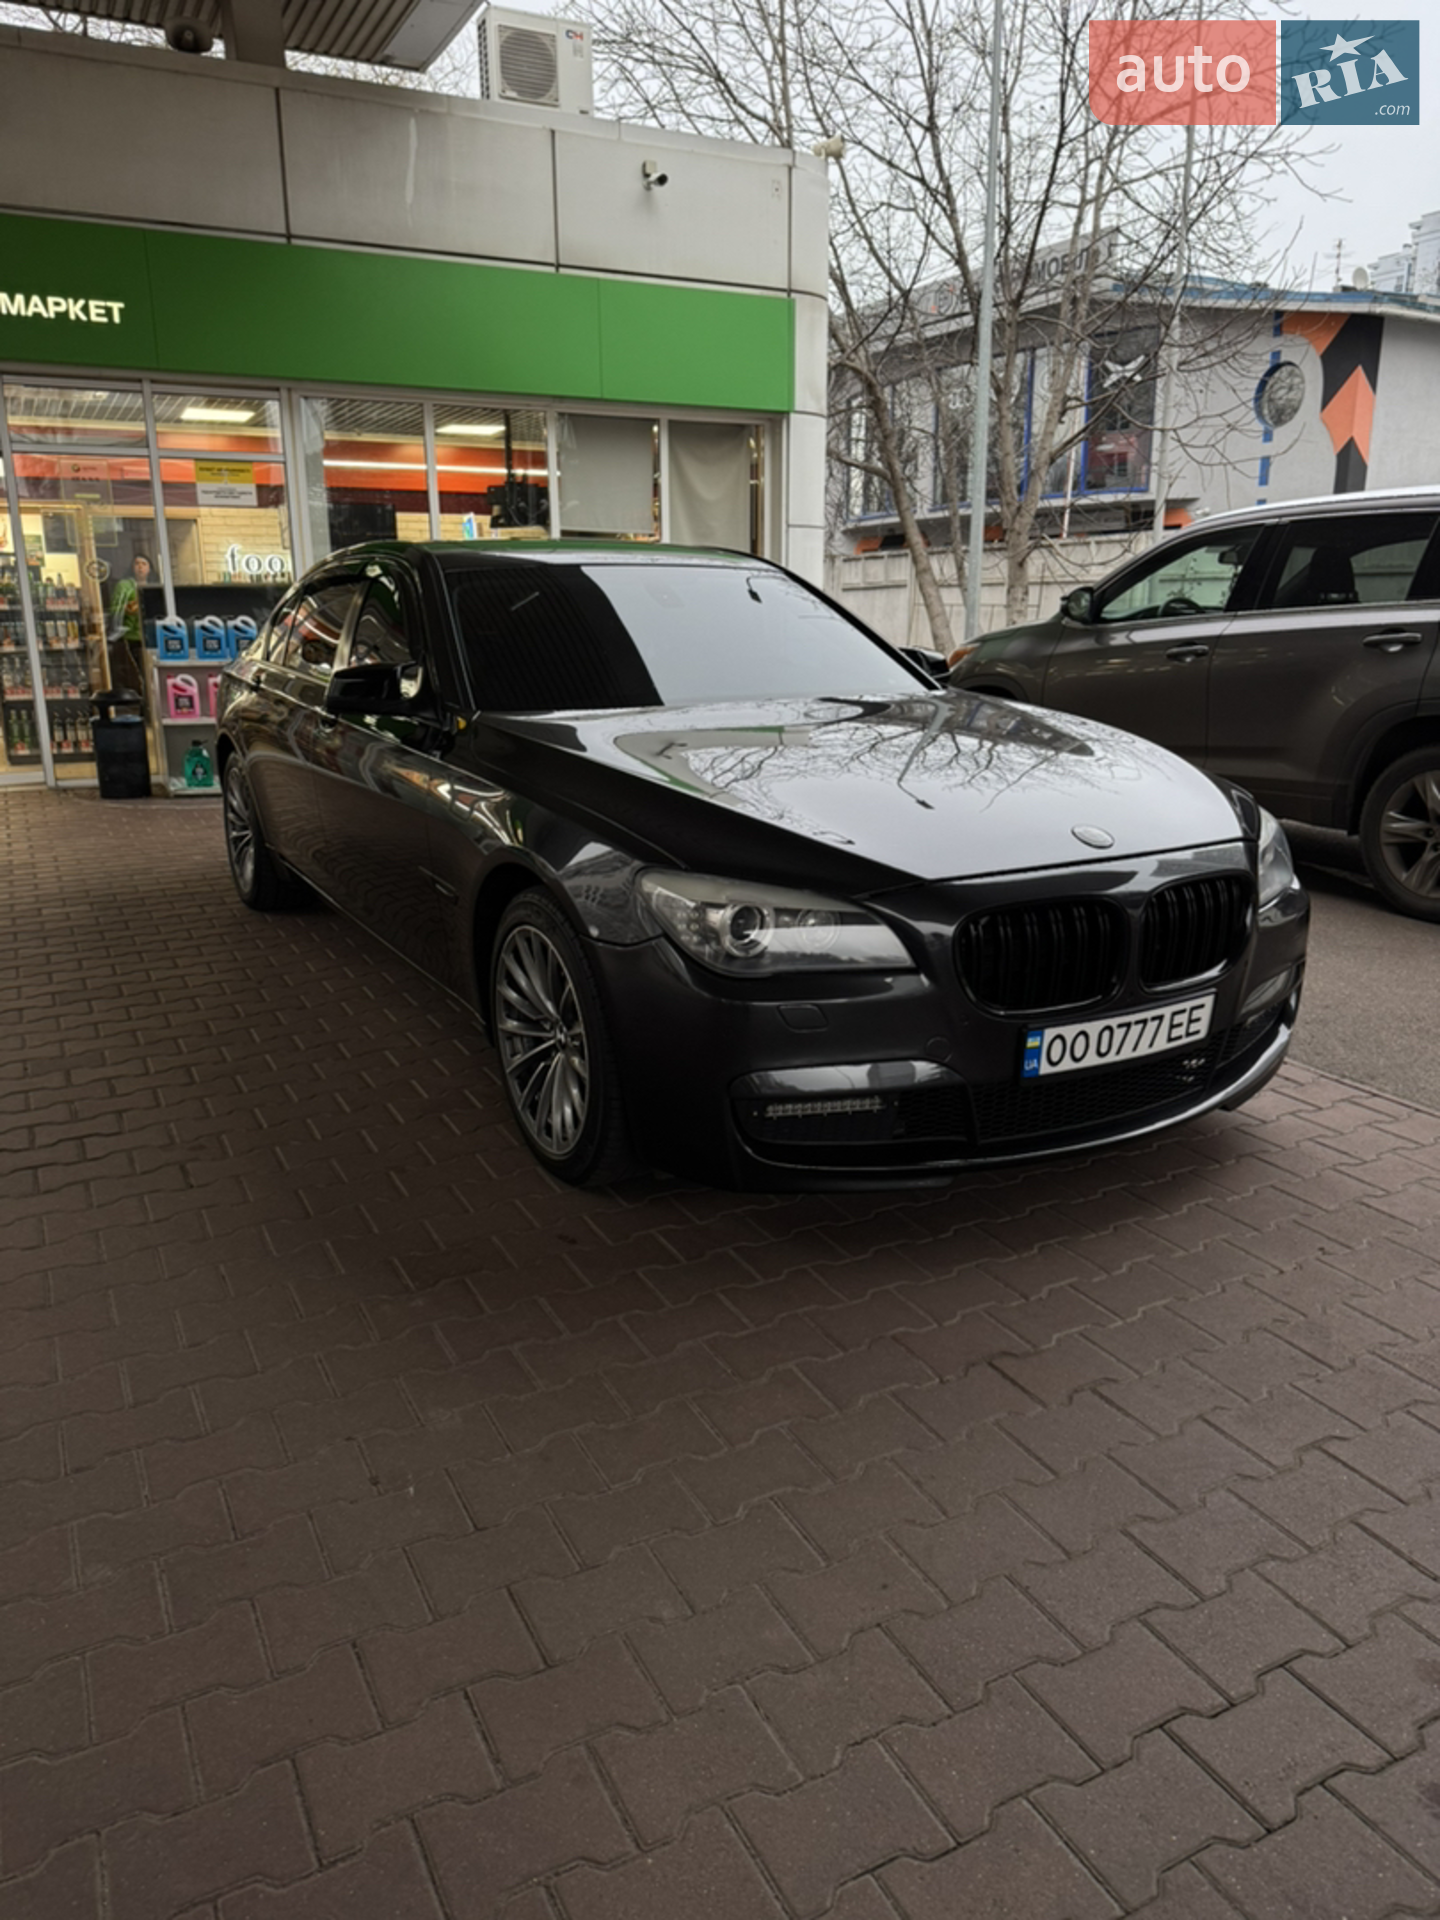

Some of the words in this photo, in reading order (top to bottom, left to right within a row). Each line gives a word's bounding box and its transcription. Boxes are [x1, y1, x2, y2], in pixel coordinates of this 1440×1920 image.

[0, 292, 125, 324] МАРКЕТ
[225, 544, 288, 575] foo
[1046, 1030, 1090, 1067] OO
[1096, 1014, 1164, 1058] 0777
[1167, 1004, 1206, 1043] EE
[1023, 1058, 1039, 1071] UA
